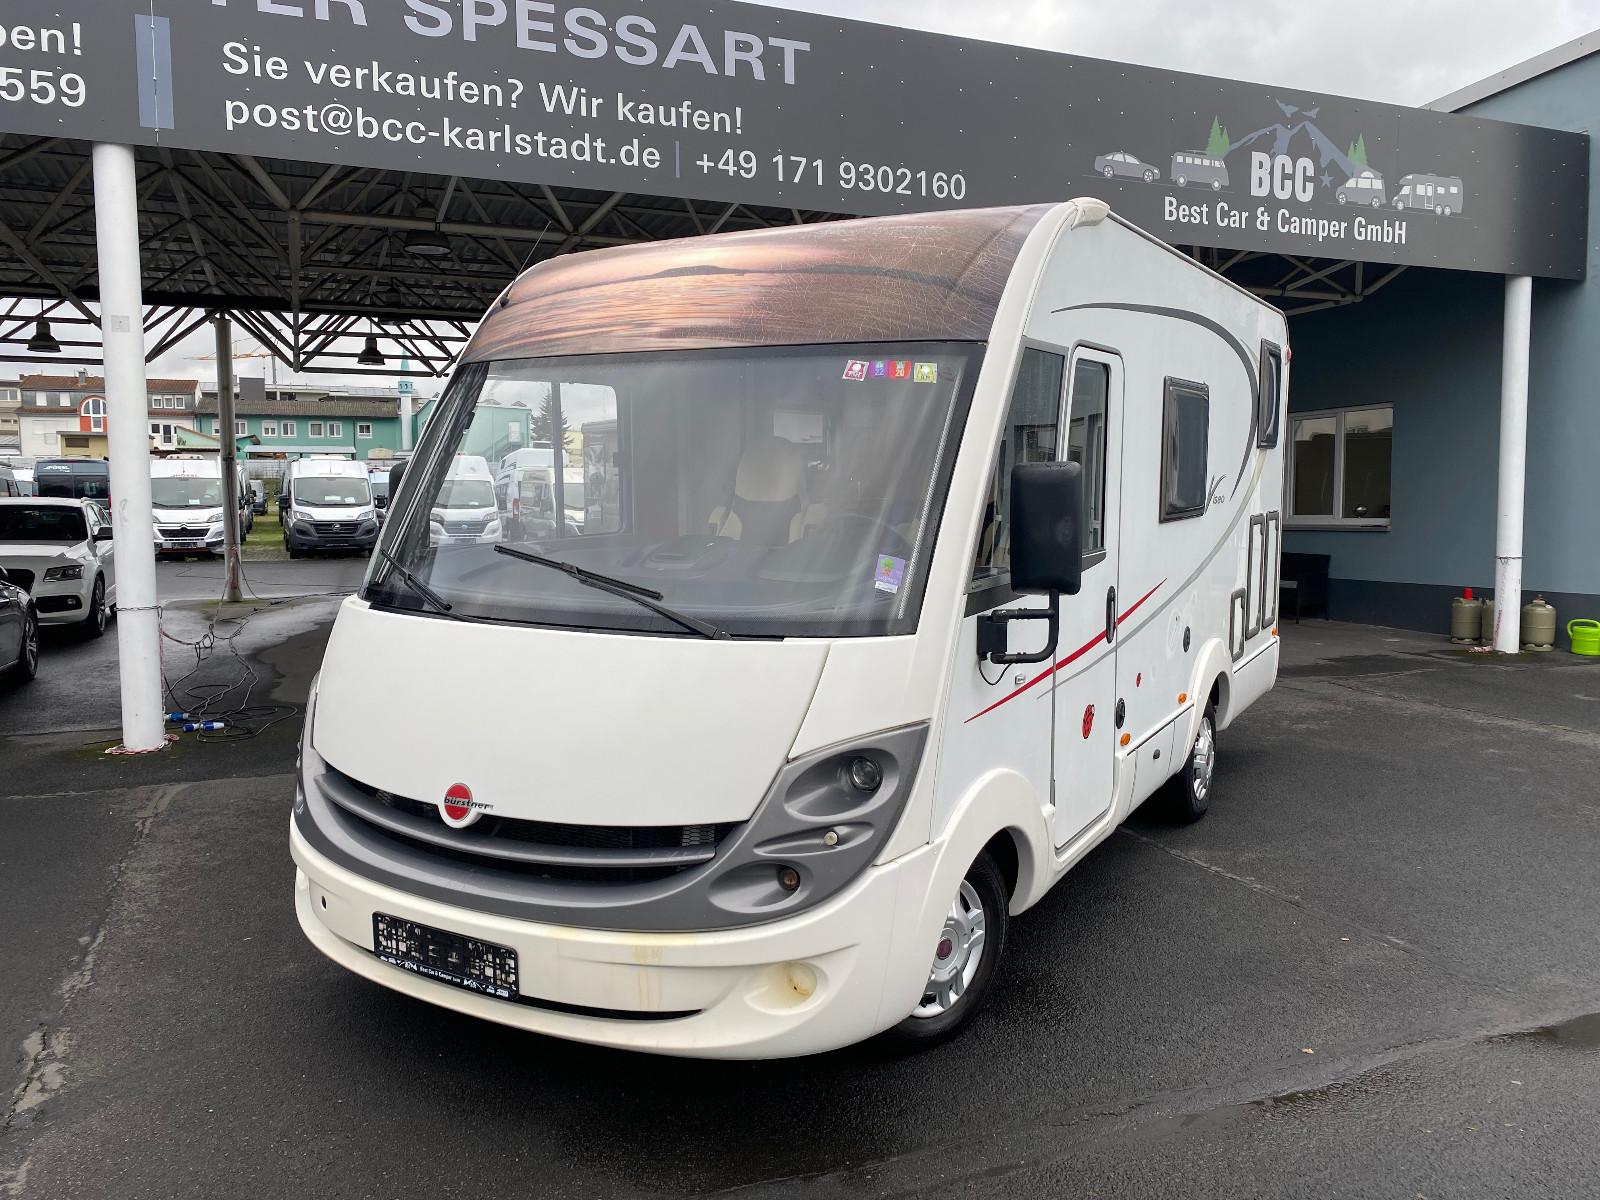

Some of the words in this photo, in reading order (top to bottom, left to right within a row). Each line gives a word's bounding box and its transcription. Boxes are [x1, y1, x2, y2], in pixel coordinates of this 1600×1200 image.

[403, 0, 811, 85] SPESSART
[222, 41, 289, 80] Sie
[303, 60, 524, 109] verkaufen?
[538, 81, 604, 118] Wir
[617, 92, 743, 135] kaufen!
[225, 99, 661, 169] post@bcc-karlstadt.de
[695, 148, 757, 179] +49
[772, 154, 824, 186] 171
[839, 161, 966, 201] 9302160
[1250, 151, 1315, 203] BCC
[1164, 196, 1209, 225] Best
[1216, 201, 1249, 229] Car
[1256, 206, 1271, 231] &
[1277, 208, 1348, 242] Camper
[1353, 216, 1407, 245] GmbH
[443, 794, 490, 810] bürstner
